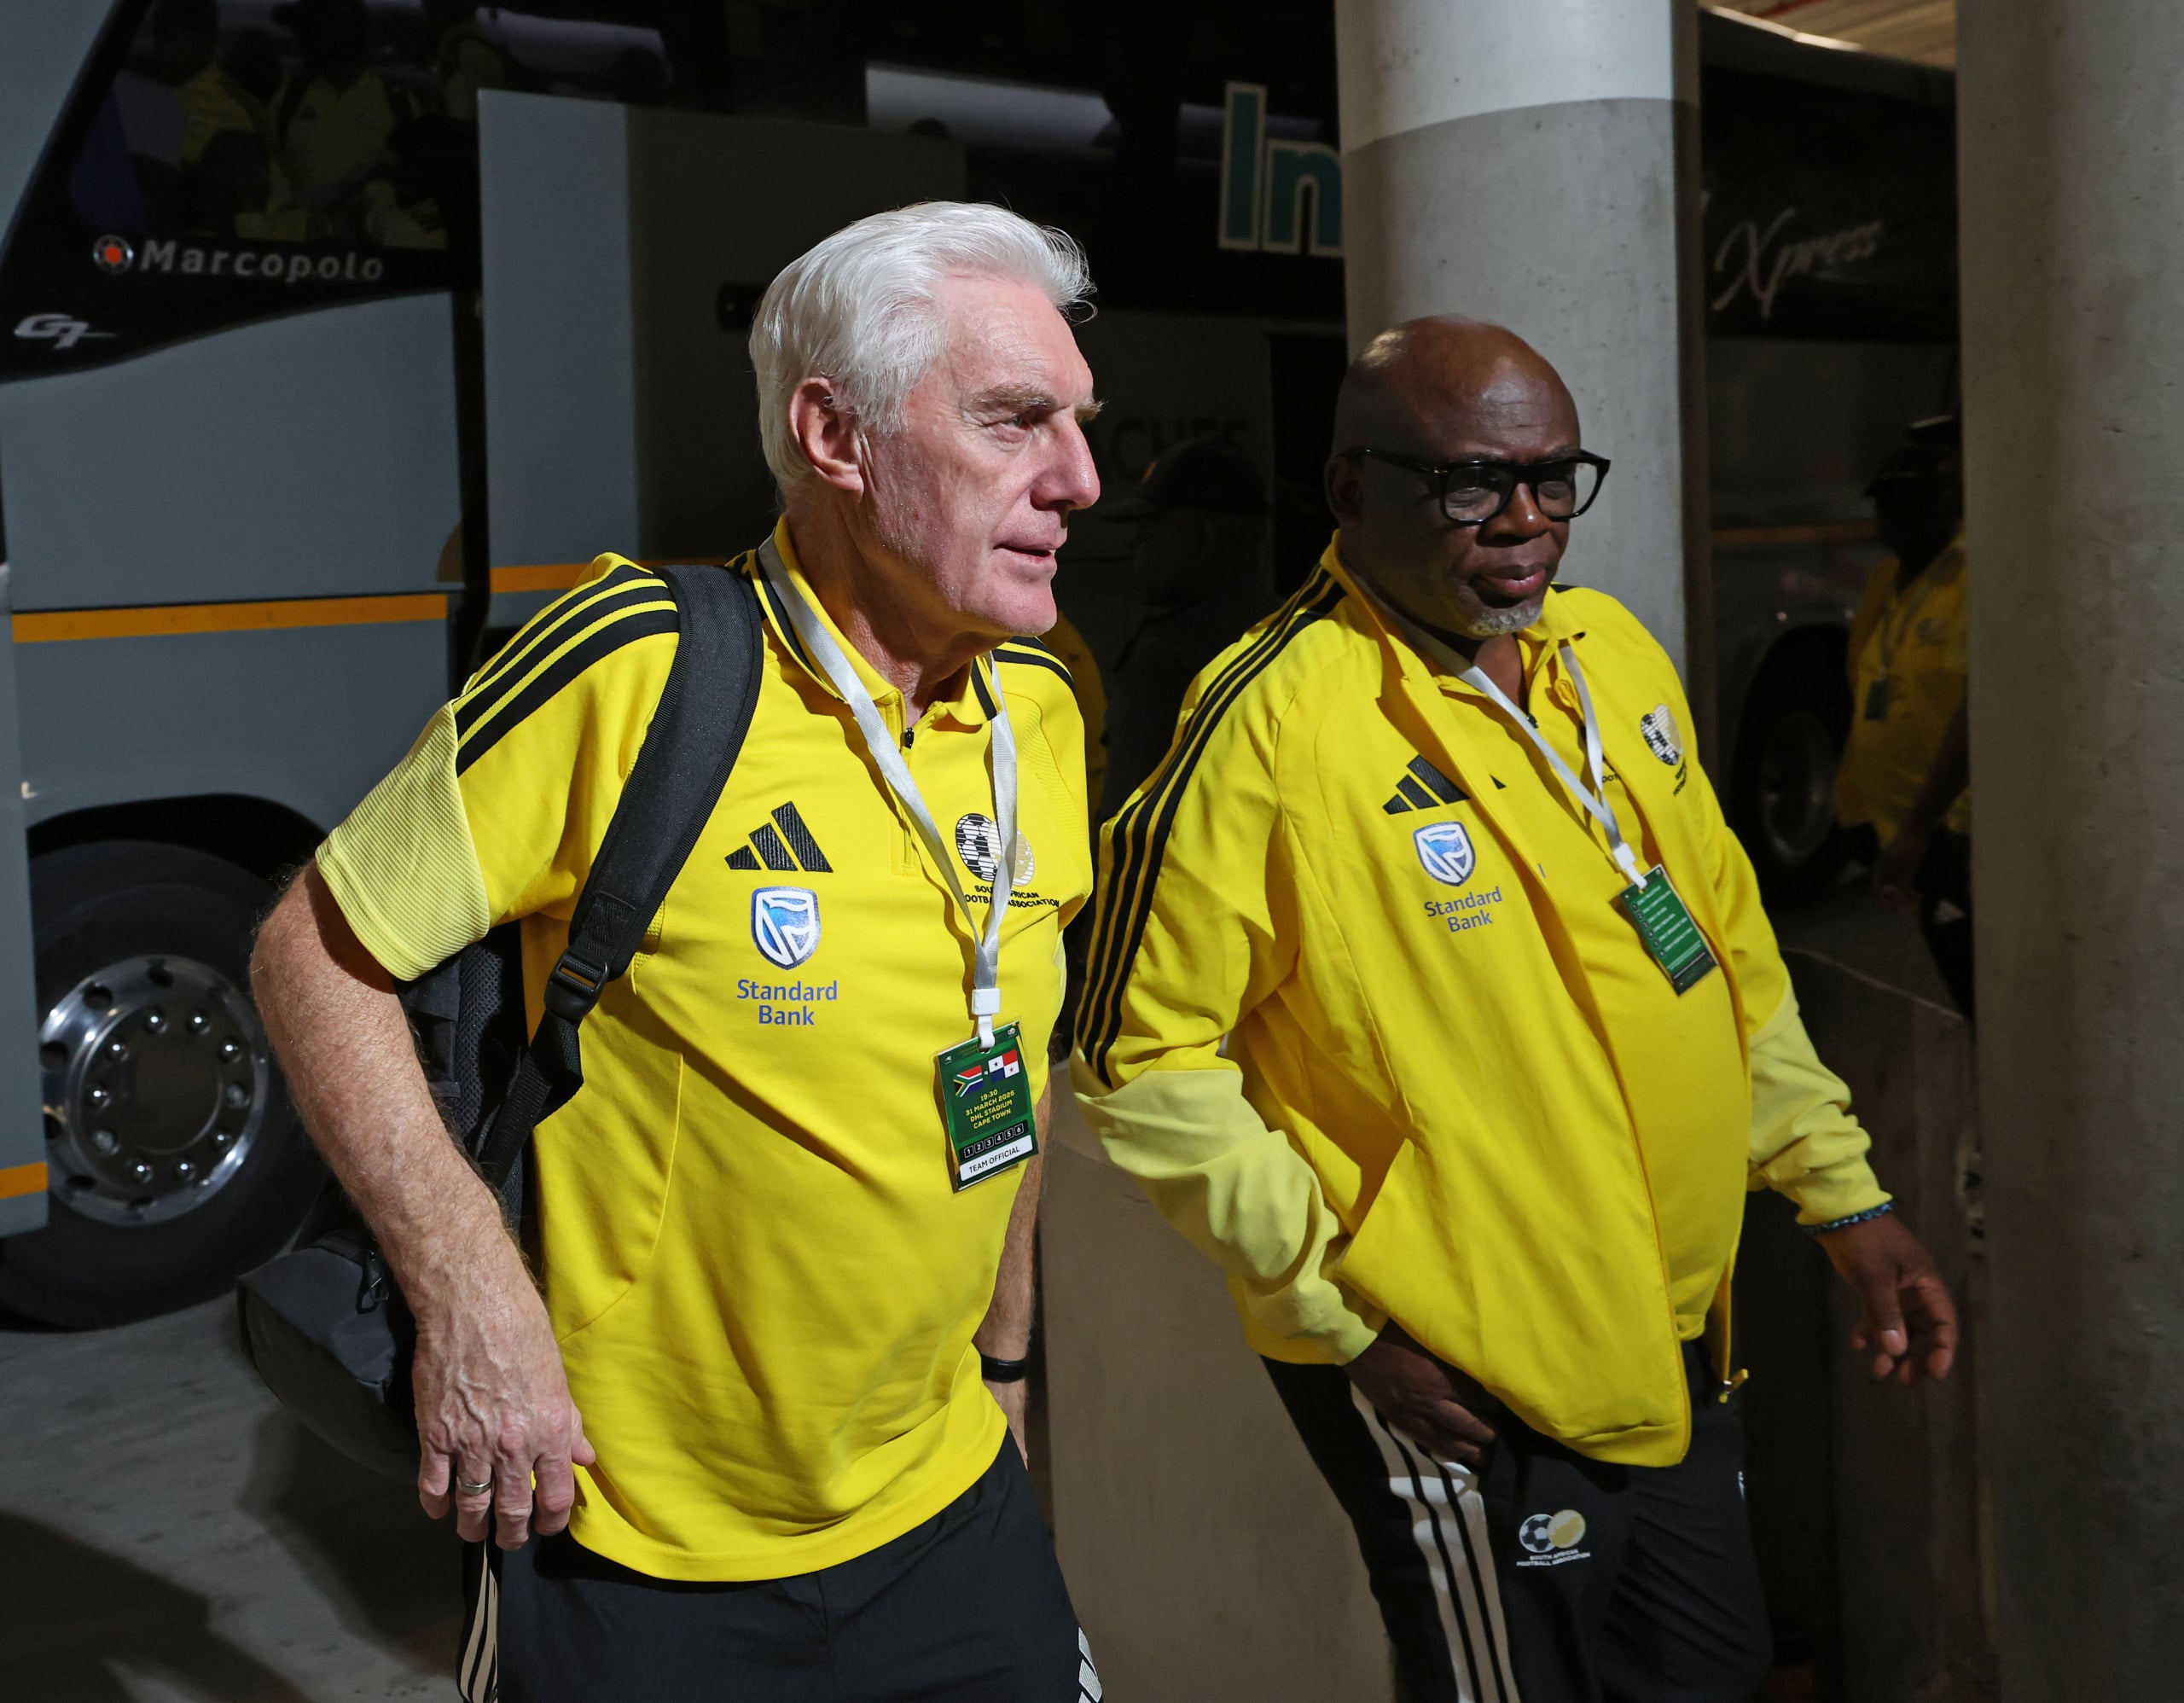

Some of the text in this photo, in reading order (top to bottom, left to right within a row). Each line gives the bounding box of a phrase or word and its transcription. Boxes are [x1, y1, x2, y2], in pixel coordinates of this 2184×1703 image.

[139, 239, 384, 283] Marcopolo
[974, 885, 993, 893] SOU
[1424, 886, 1502, 917] Standard
[1447, 910, 1493, 933] Bank
[737, 979, 838, 1001] Standard
[758, 1005, 815, 1026] Bank
[966, 1090, 1015, 1116] 31 MARCH 2026
[980, 1089, 998, 1101] 19:30
[970, 1100, 1013, 1123] DHL STADIUM
[973, 1108, 1012, 1129] CAPE TOWN
[969, 1146, 1020, 1173] TEAM OFFICIAL
